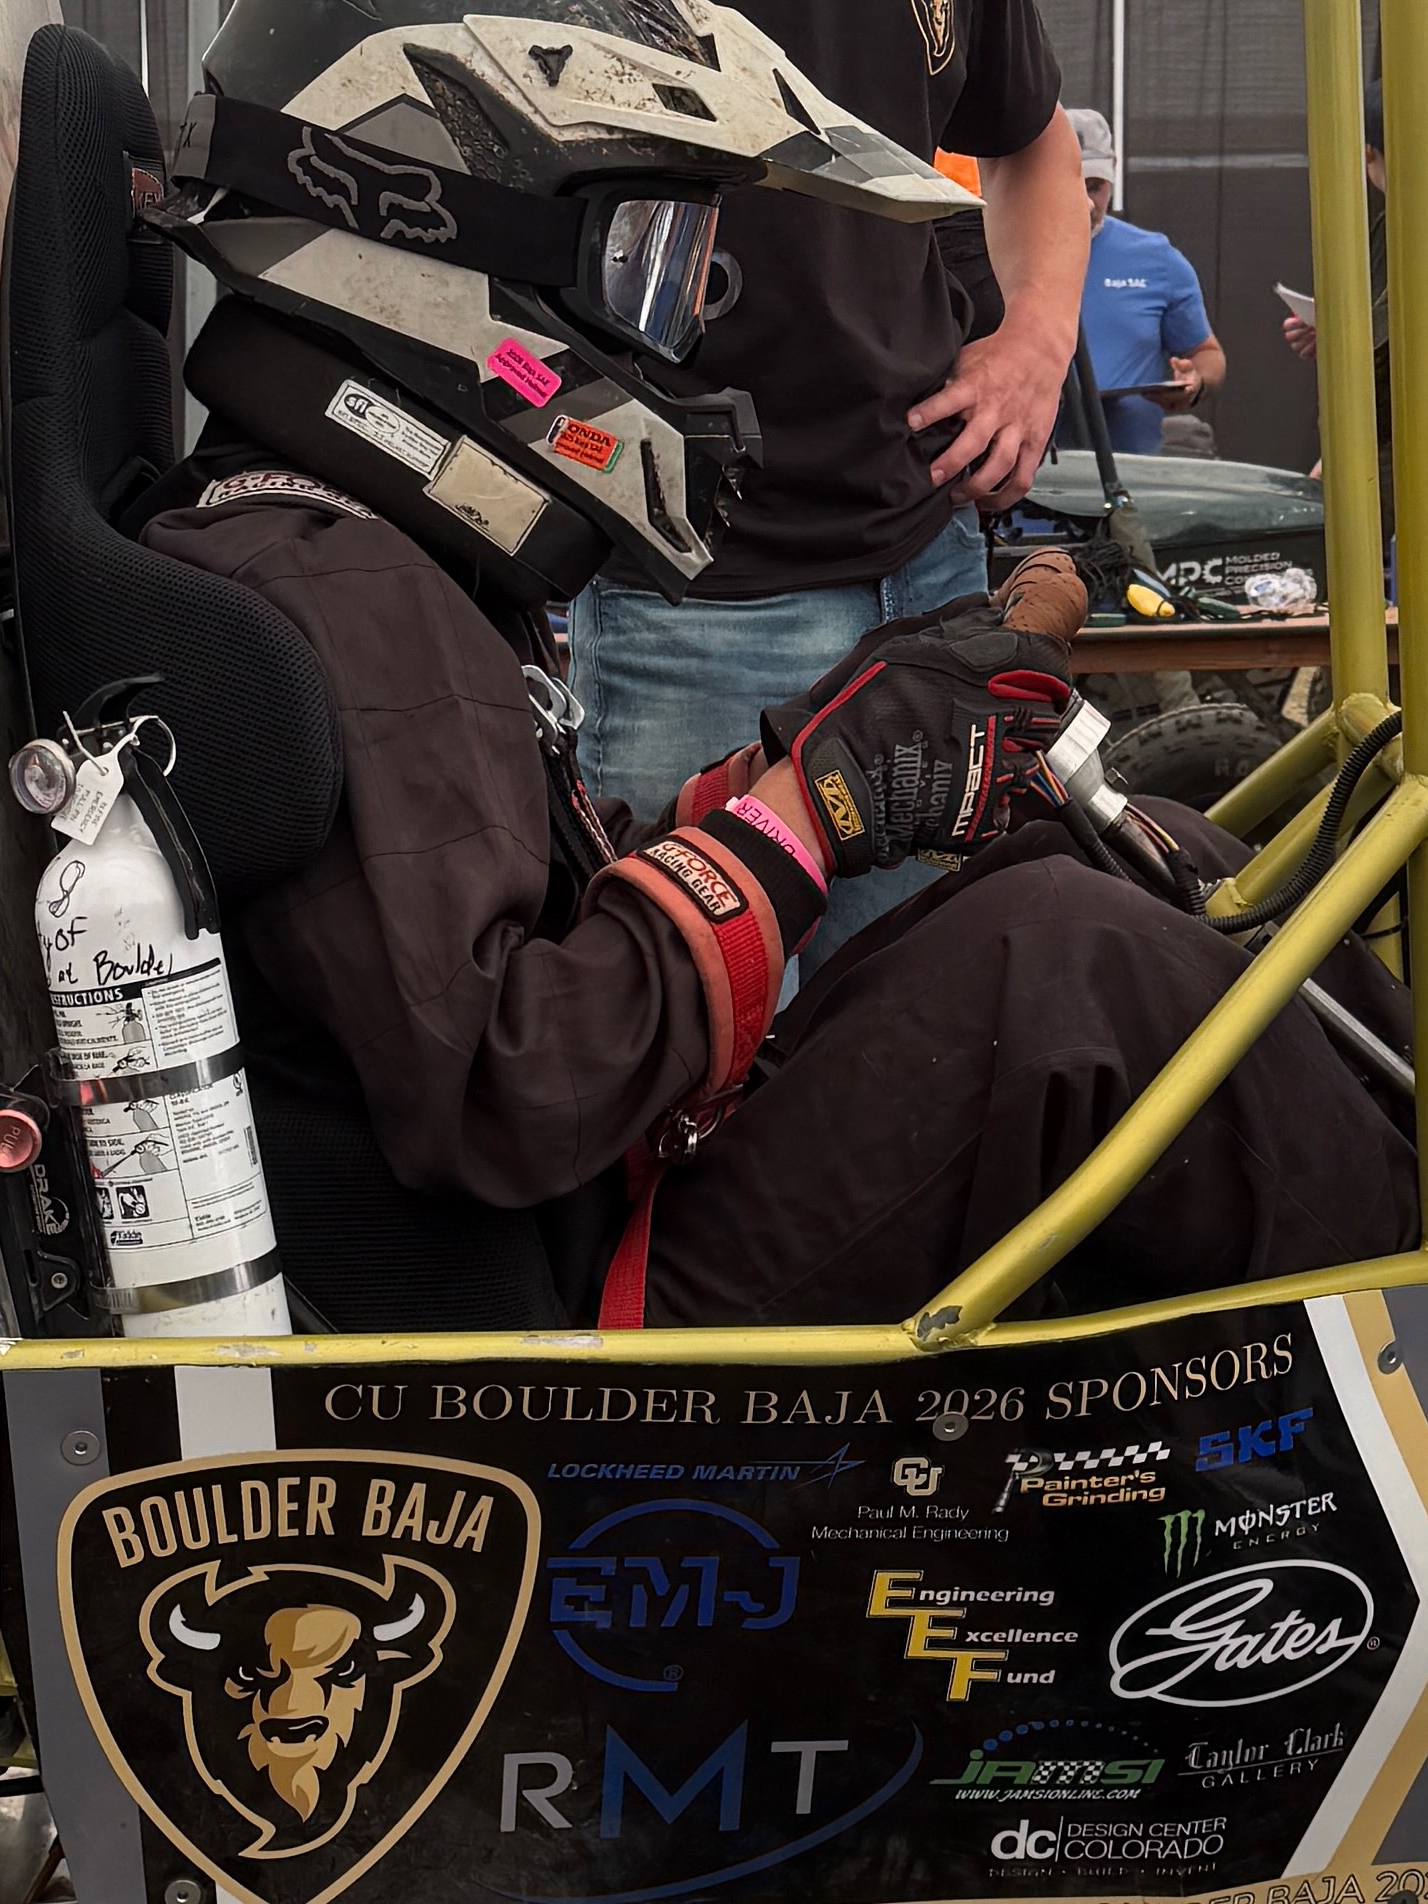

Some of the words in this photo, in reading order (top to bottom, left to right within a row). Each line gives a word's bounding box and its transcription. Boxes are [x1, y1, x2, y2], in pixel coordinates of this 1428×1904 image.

[1225, 552, 1281, 565] MOLDED
[1225, 561, 1293, 574] PRECISION
[886, 743, 923, 840] Mechanix
[690, 876, 723, 913] GEAR
[34, 1164, 61, 1236] DRAKE
[325, 1384, 408, 1425] CU
[431, 1385, 721, 1426] BOULDER
[743, 1388, 893, 1426] BAJA
[917, 1387, 1026, 1426] 2026
[1045, 1333, 1295, 1421] SPONSORS
[1195, 1407, 1314, 1472] SKF
[547, 1462, 685, 1481] LOCKHEED
[692, 1464, 801, 1482] MARTIN
[891, 1455, 946, 1497] CU
[1020, 1469, 1157, 1495] Painter's
[857, 1504, 894, 1520] Paul
[899, 1505, 920, 1520] M.
[925, 1505, 971, 1523] Rady
[1042, 1486, 1167, 1509] Grinding
[1214, 1490, 1339, 1539] MONSTER
[101, 1475, 336, 1569] BOULDER
[361, 1481, 495, 1554] BAJA
[811, 1524, 907, 1541] Mechanical
[912, 1525, 1010, 1544] Engineering
[1232, 1522, 1322, 1550] ENERGY
[867, 1569, 1056, 1618] Engineering
[903, 1607, 1079, 1660] Excellence
[1147, 1577, 1361, 1678] Gates
[947, 1649, 1056, 1702] Fund
[1183, 1739, 1271, 1773] Taylor
[1284, 1723, 1345, 1756] Clark
[499, 1720, 850, 1840] RMT
[1201, 1758, 1320, 1790] GALLERY
[990, 1819, 1059, 1862] dc
[1063, 1833, 1225, 1861] COLORADO
[1067, 1823, 1143, 1838] DESIGN
[1148, 1817, 1228, 1837] CENTER
